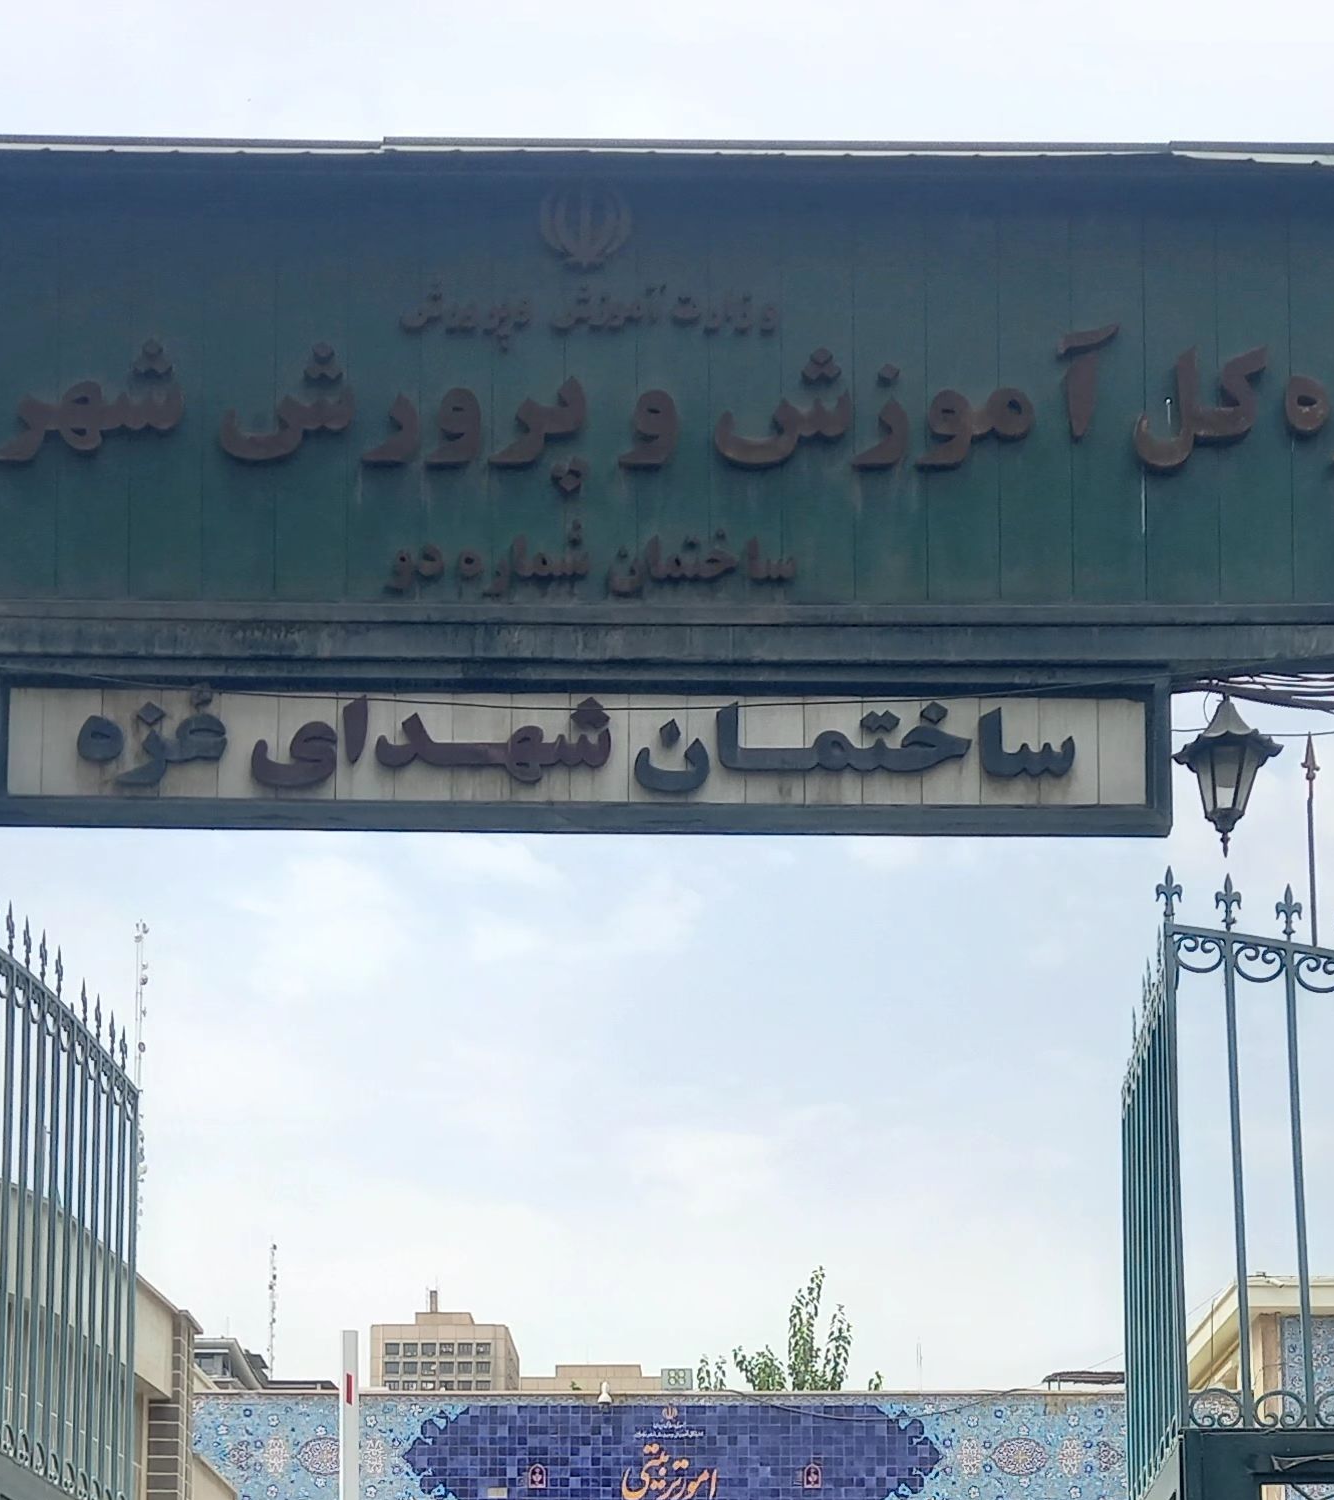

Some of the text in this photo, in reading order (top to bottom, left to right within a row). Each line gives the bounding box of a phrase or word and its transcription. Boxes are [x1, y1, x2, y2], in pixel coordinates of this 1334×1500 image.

[220, 338, 589, 496] پرورش
[618, 386, 678, 469] و
[713, 322, 1122, 470] آموزش
[1133, 343, 1269, 476] کل
[384, 519, 797, 596] ساختمان شماره دو
[76, 685, 1076, 792] ساختمان شهدای غزه
[672, 1467, 718, 1500] امور
